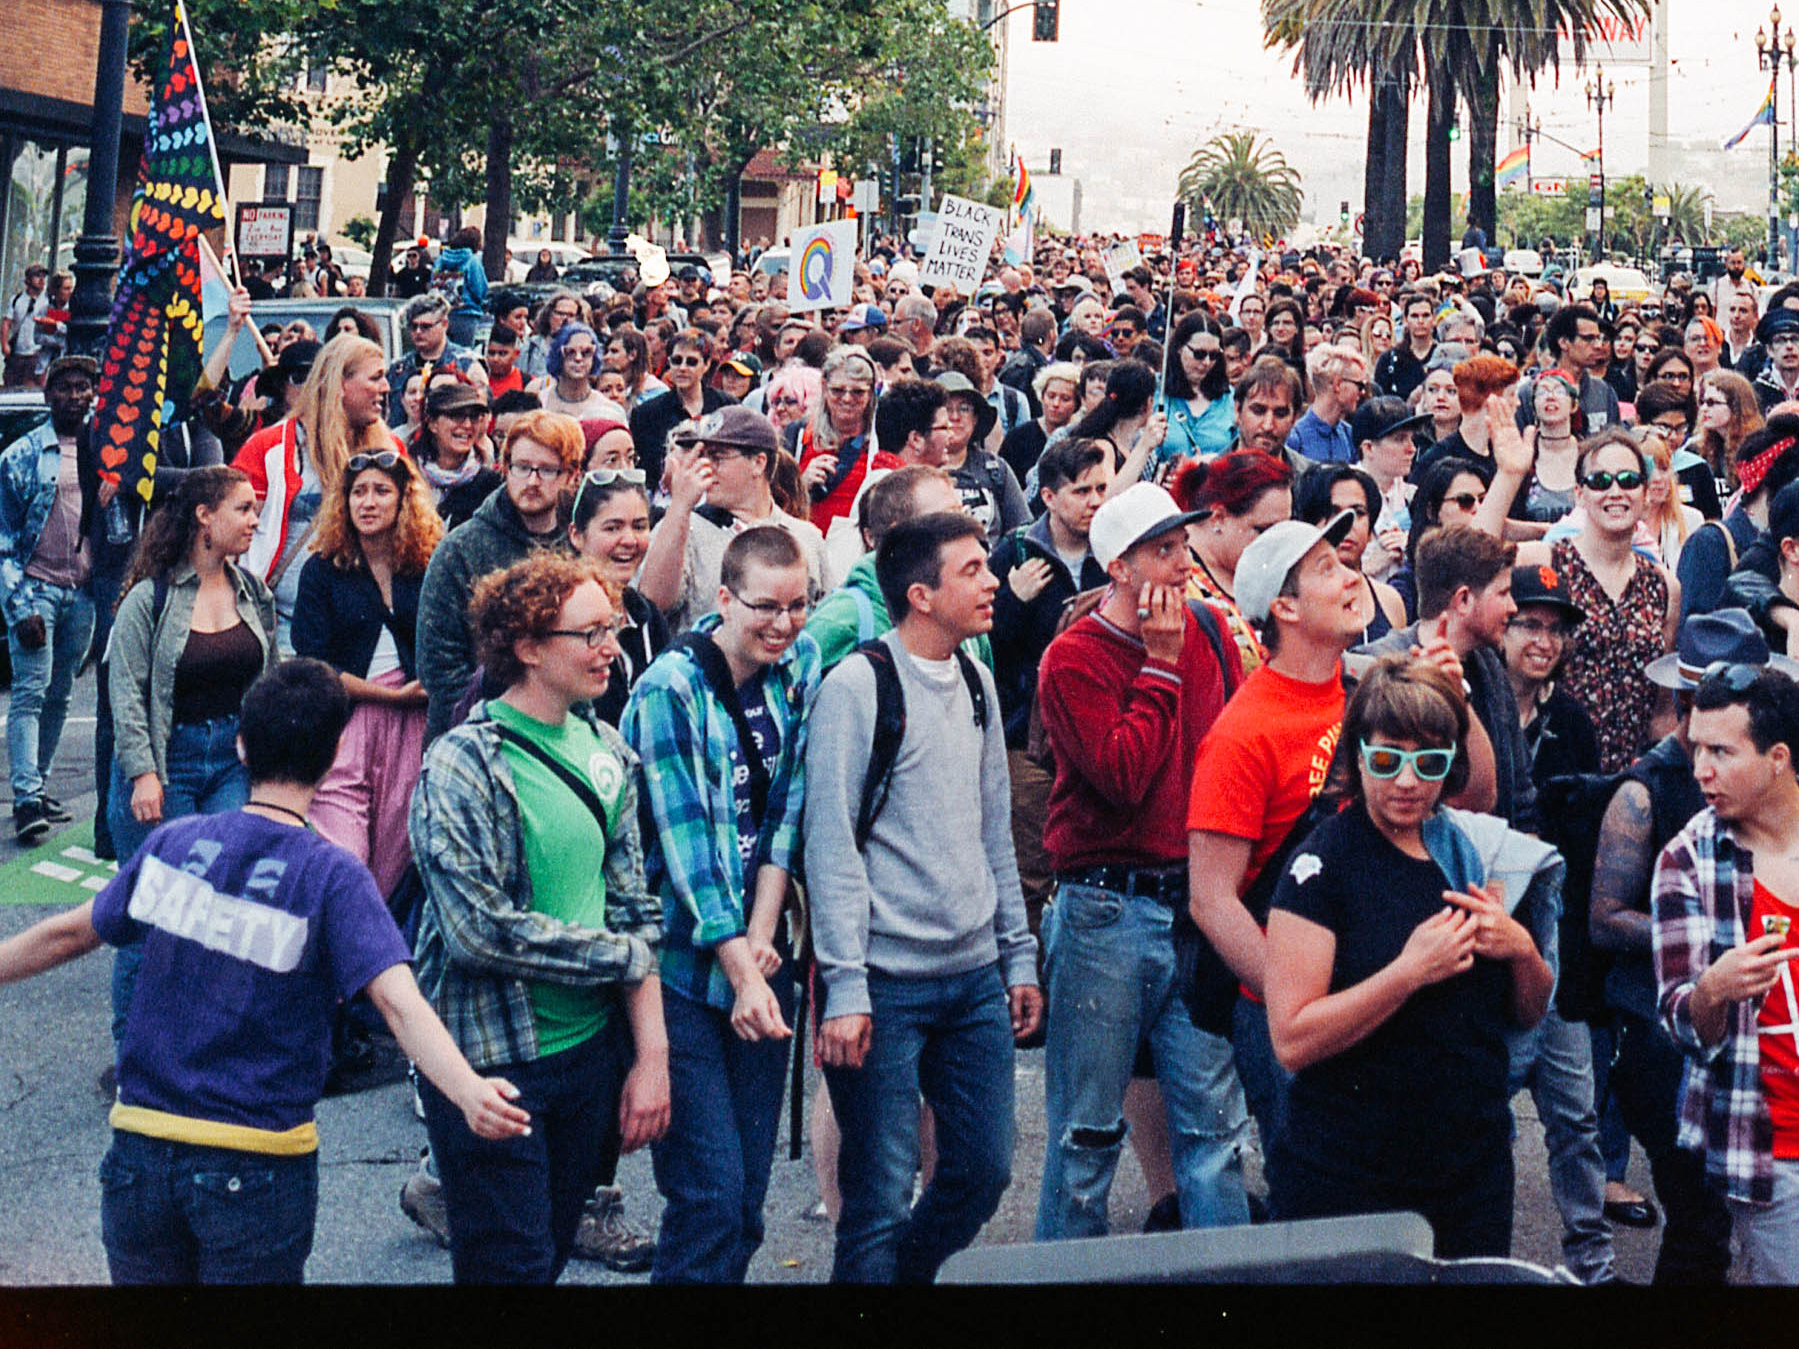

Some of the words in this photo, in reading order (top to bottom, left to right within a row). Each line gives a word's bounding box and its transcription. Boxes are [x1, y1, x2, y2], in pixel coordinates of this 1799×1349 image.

[945, 199, 992, 227] BLACK
[944, 222, 984, 247] TRANS
[939, 241, 978, 263] LIVES
[800, 237, 832, 301] Q
[927, 259, 975, 281] MATTER
[130, 854, 308, 972] SAFETY
